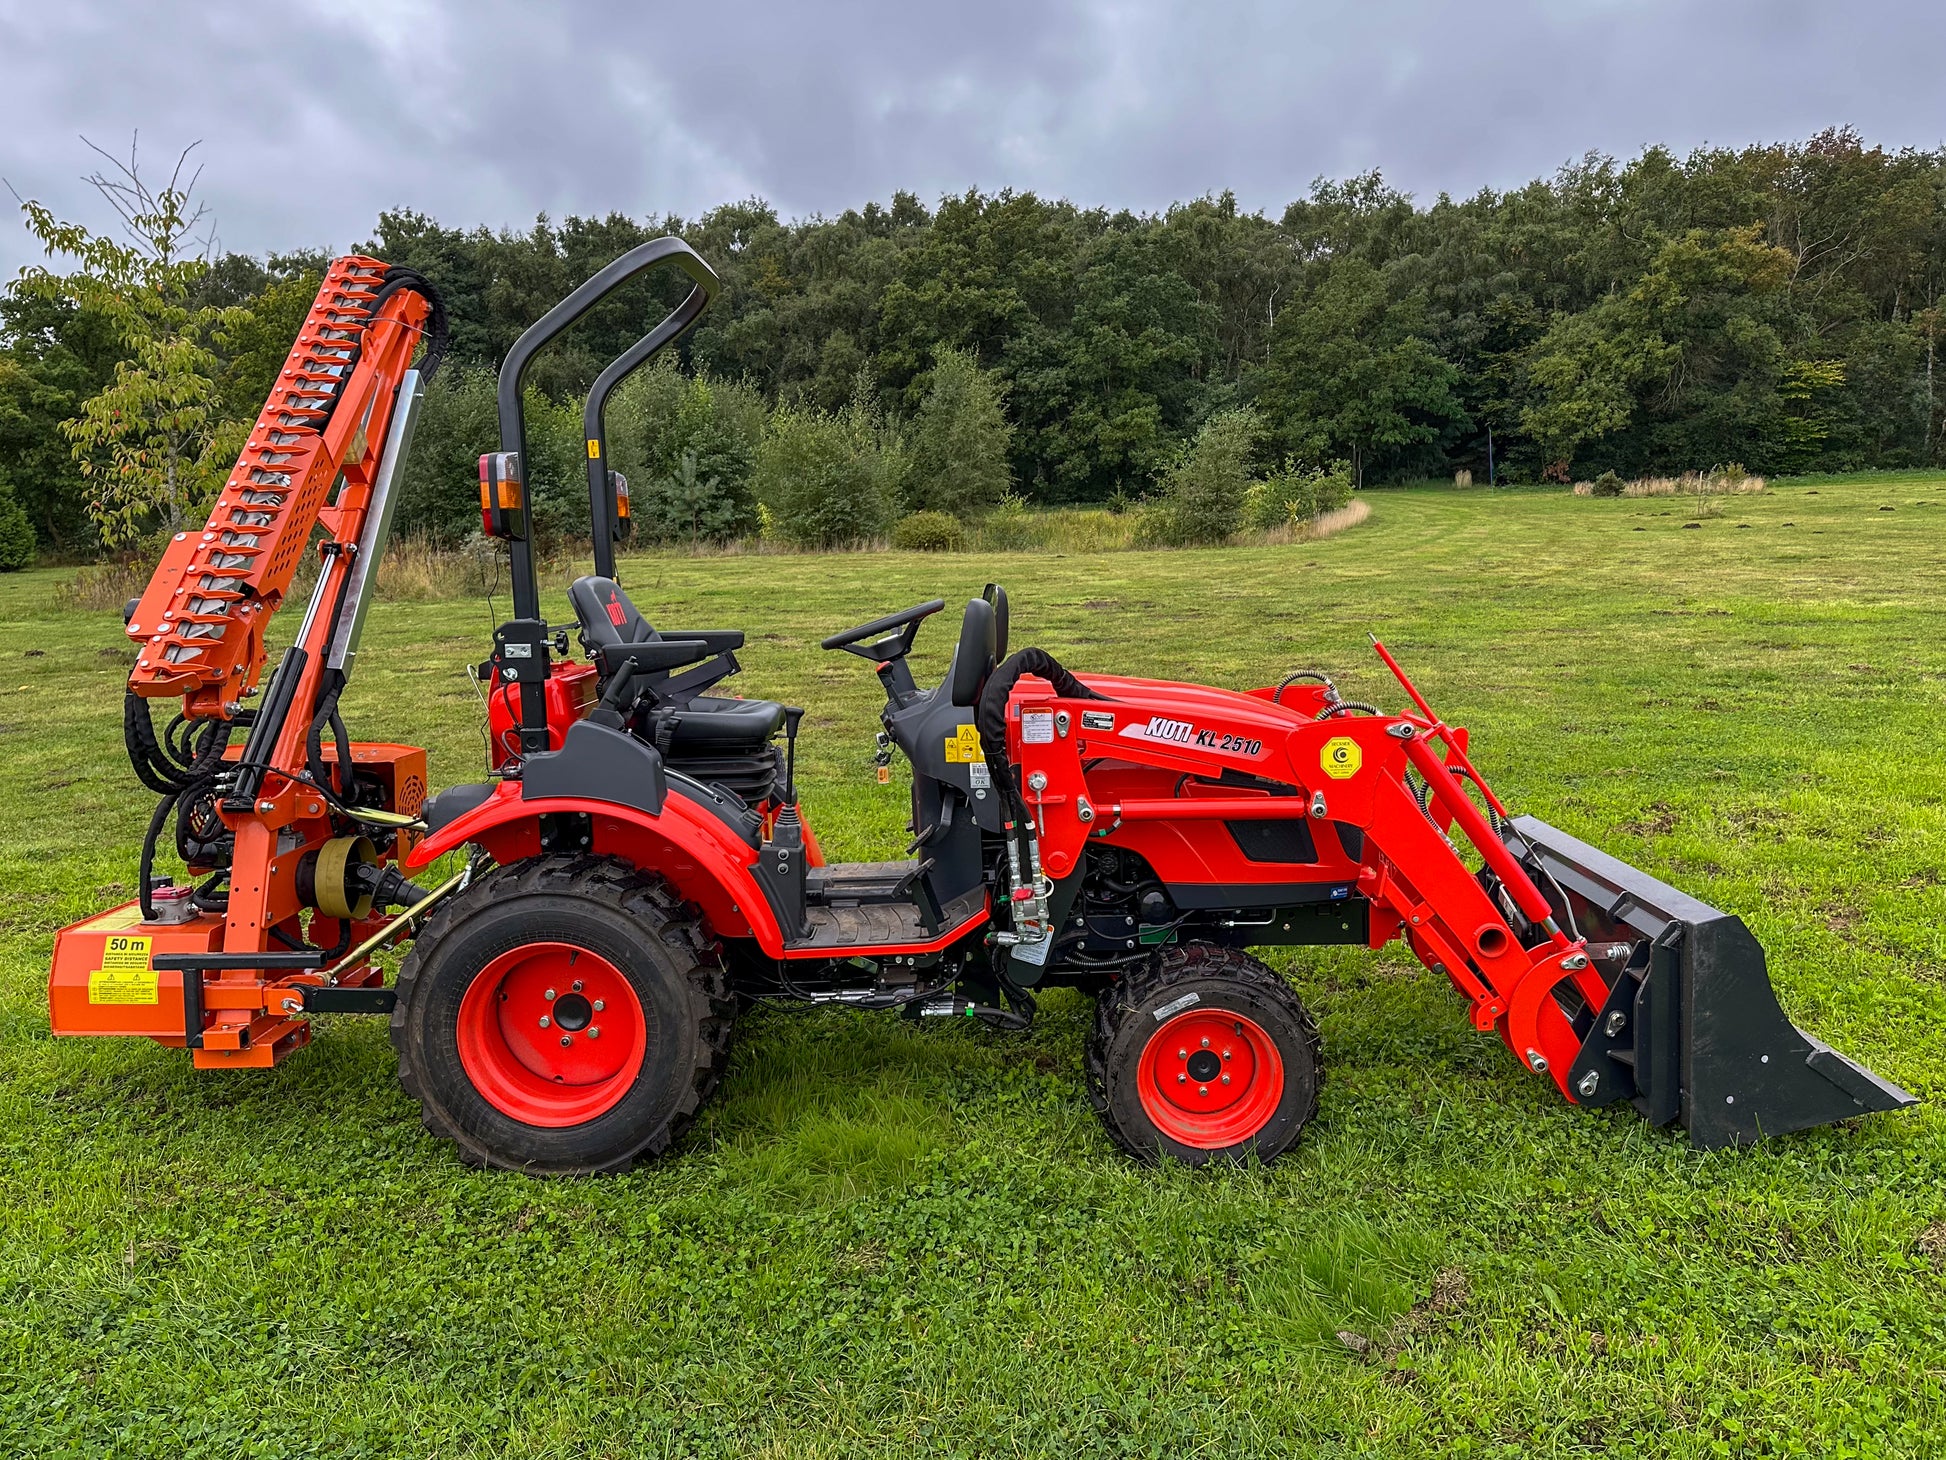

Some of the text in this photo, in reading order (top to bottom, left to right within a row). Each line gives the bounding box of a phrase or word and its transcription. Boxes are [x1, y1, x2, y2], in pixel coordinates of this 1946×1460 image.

[1144, 716, 1262, 755] KIOTI KL 2510
[110, 938, 145, 951] 50 m
